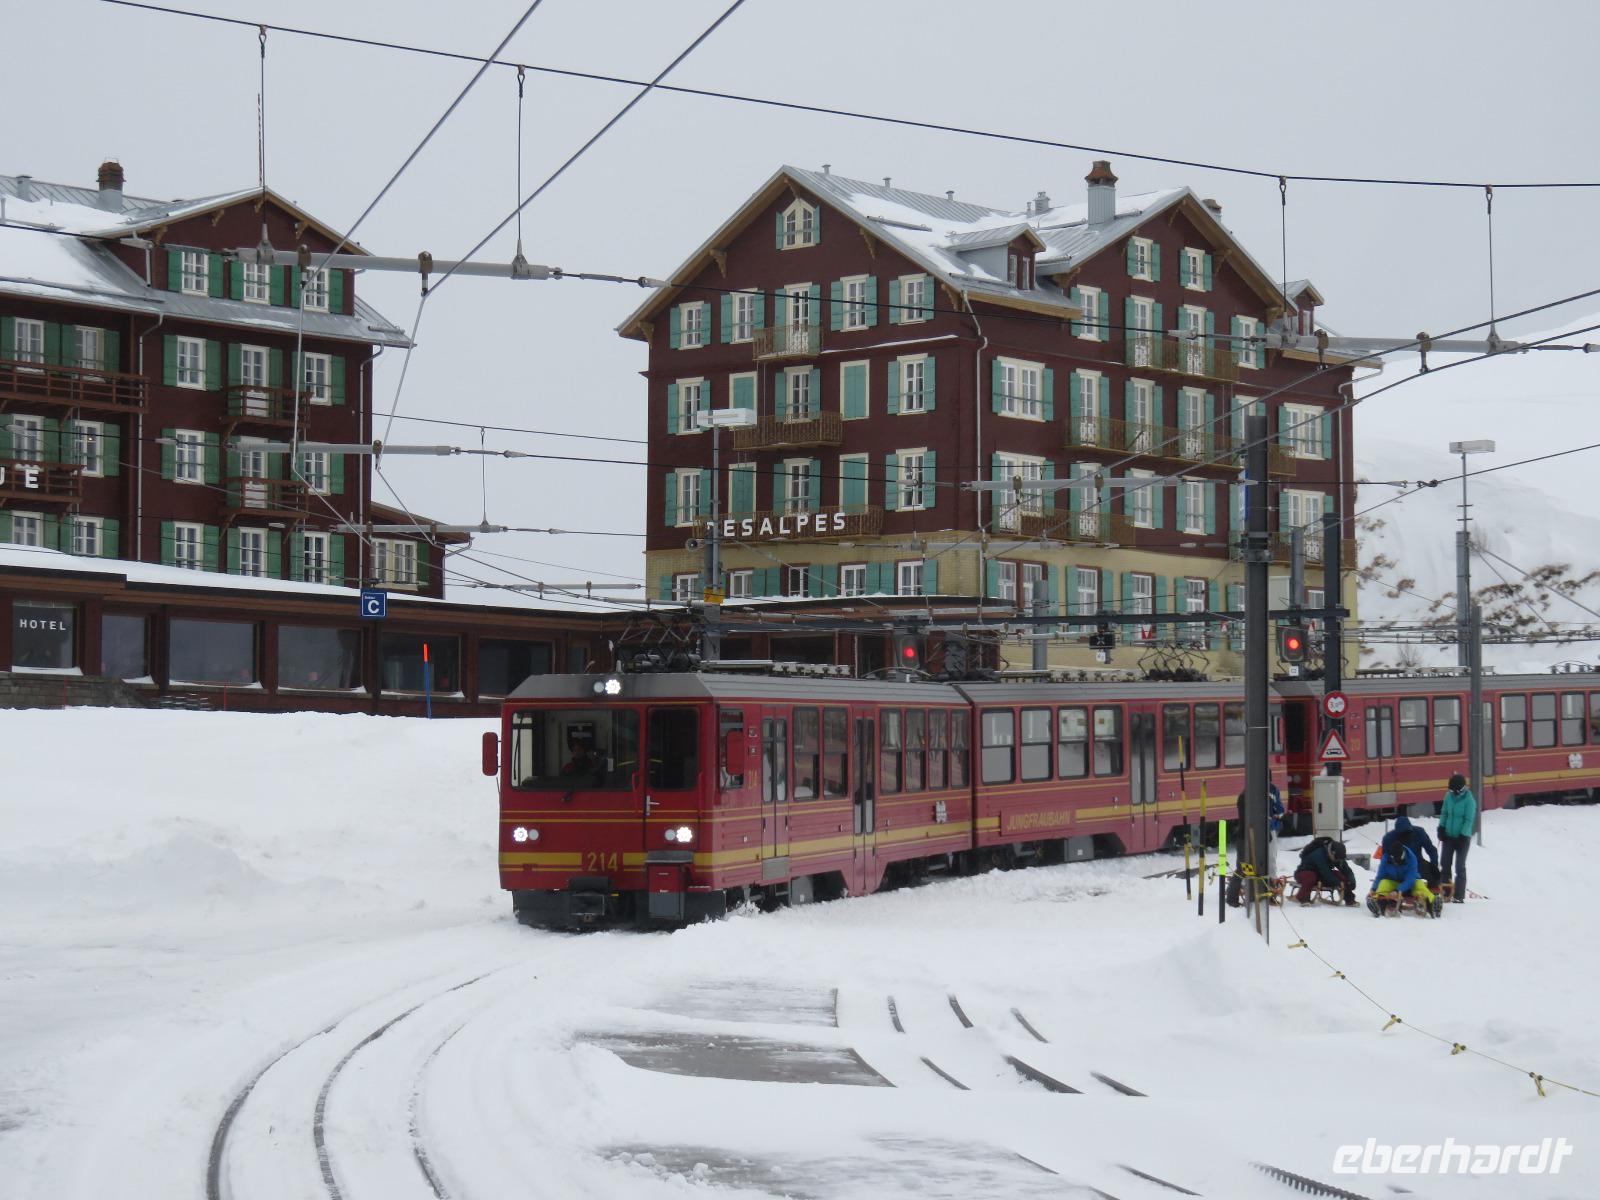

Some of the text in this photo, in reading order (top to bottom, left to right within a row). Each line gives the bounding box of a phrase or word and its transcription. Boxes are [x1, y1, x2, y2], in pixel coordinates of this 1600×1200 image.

[368, 600, 380, 614] C
[19, 619, 67, 631] HOTEL
[1007, 810, 1071, 831] JUNGFRAUBAHN
[587, 852, 618, 872] 214
